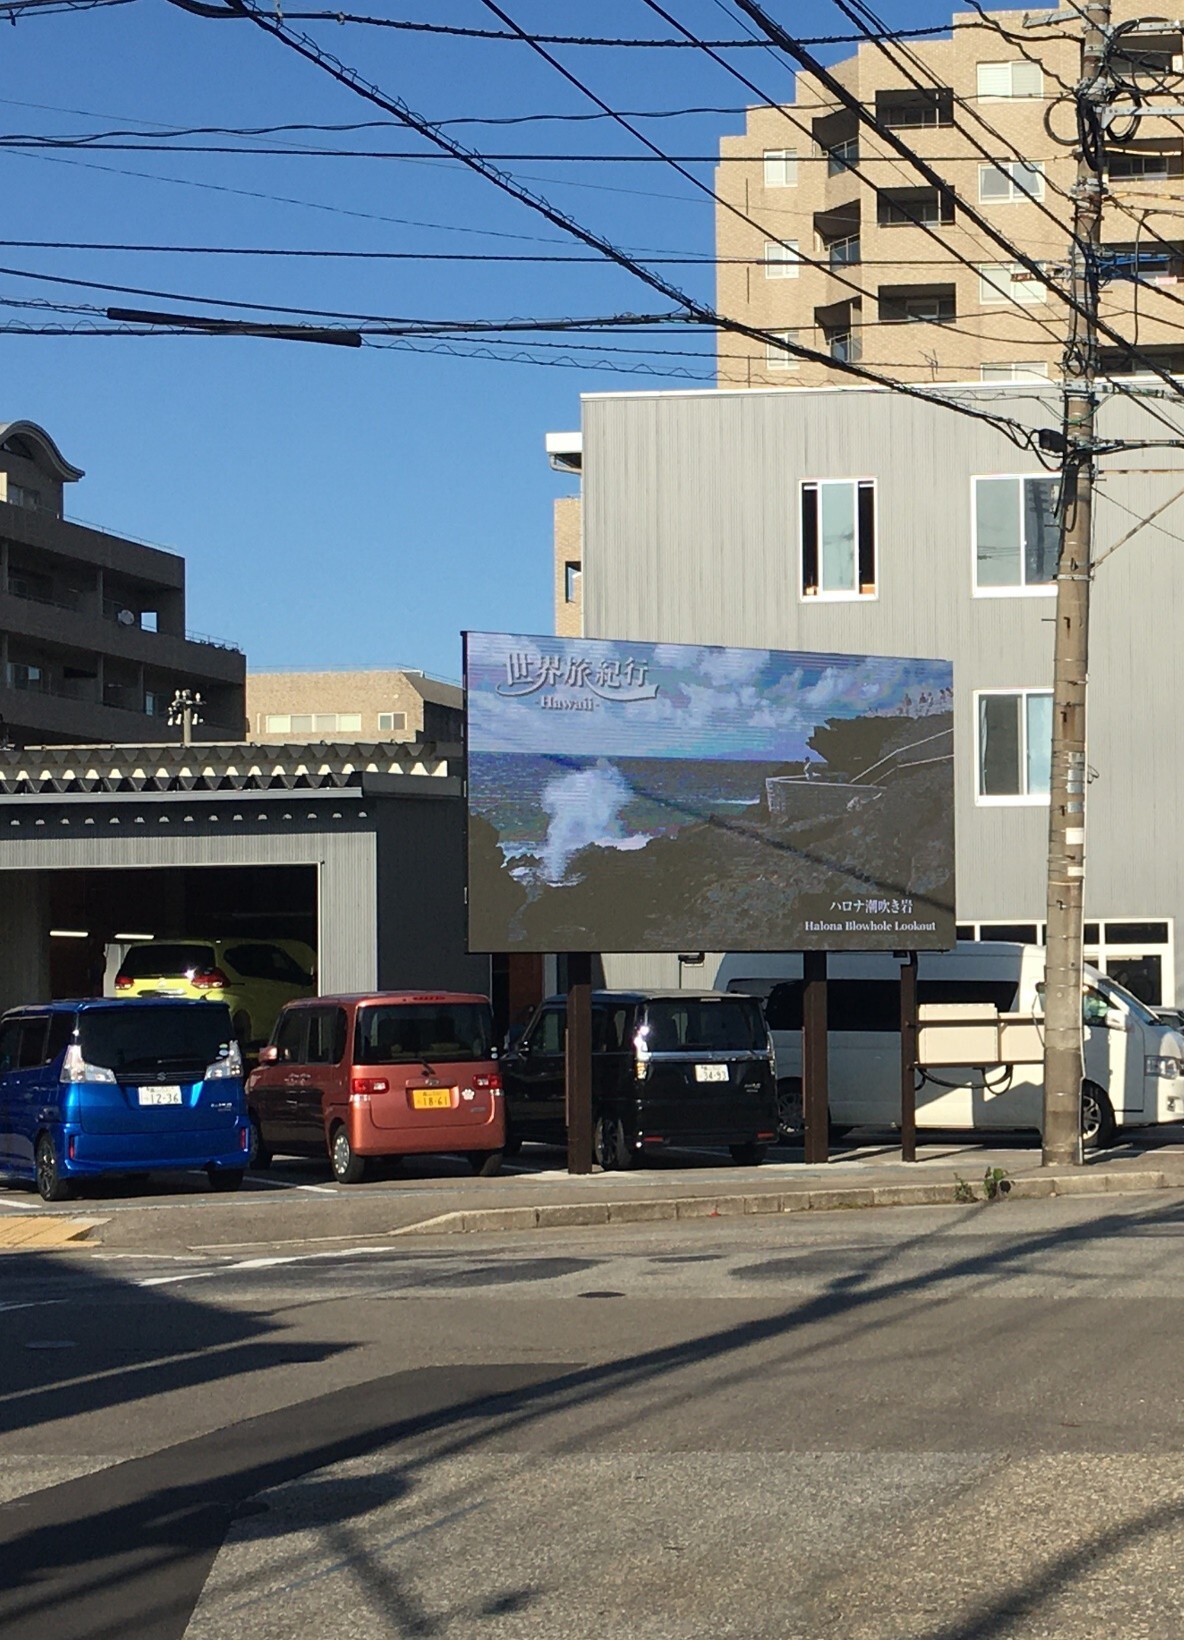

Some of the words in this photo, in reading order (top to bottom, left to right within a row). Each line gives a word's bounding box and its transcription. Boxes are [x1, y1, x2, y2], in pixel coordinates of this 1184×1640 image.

[504, 652, 652, 690] 世界旅紀行
[829, 898, 913, 914] ハロナ潮吹き岩
[804, 921, 843, 931] Halona
[845, 921, 893, 931] Blowhole
[894, 921, 936, 931] Lookout
